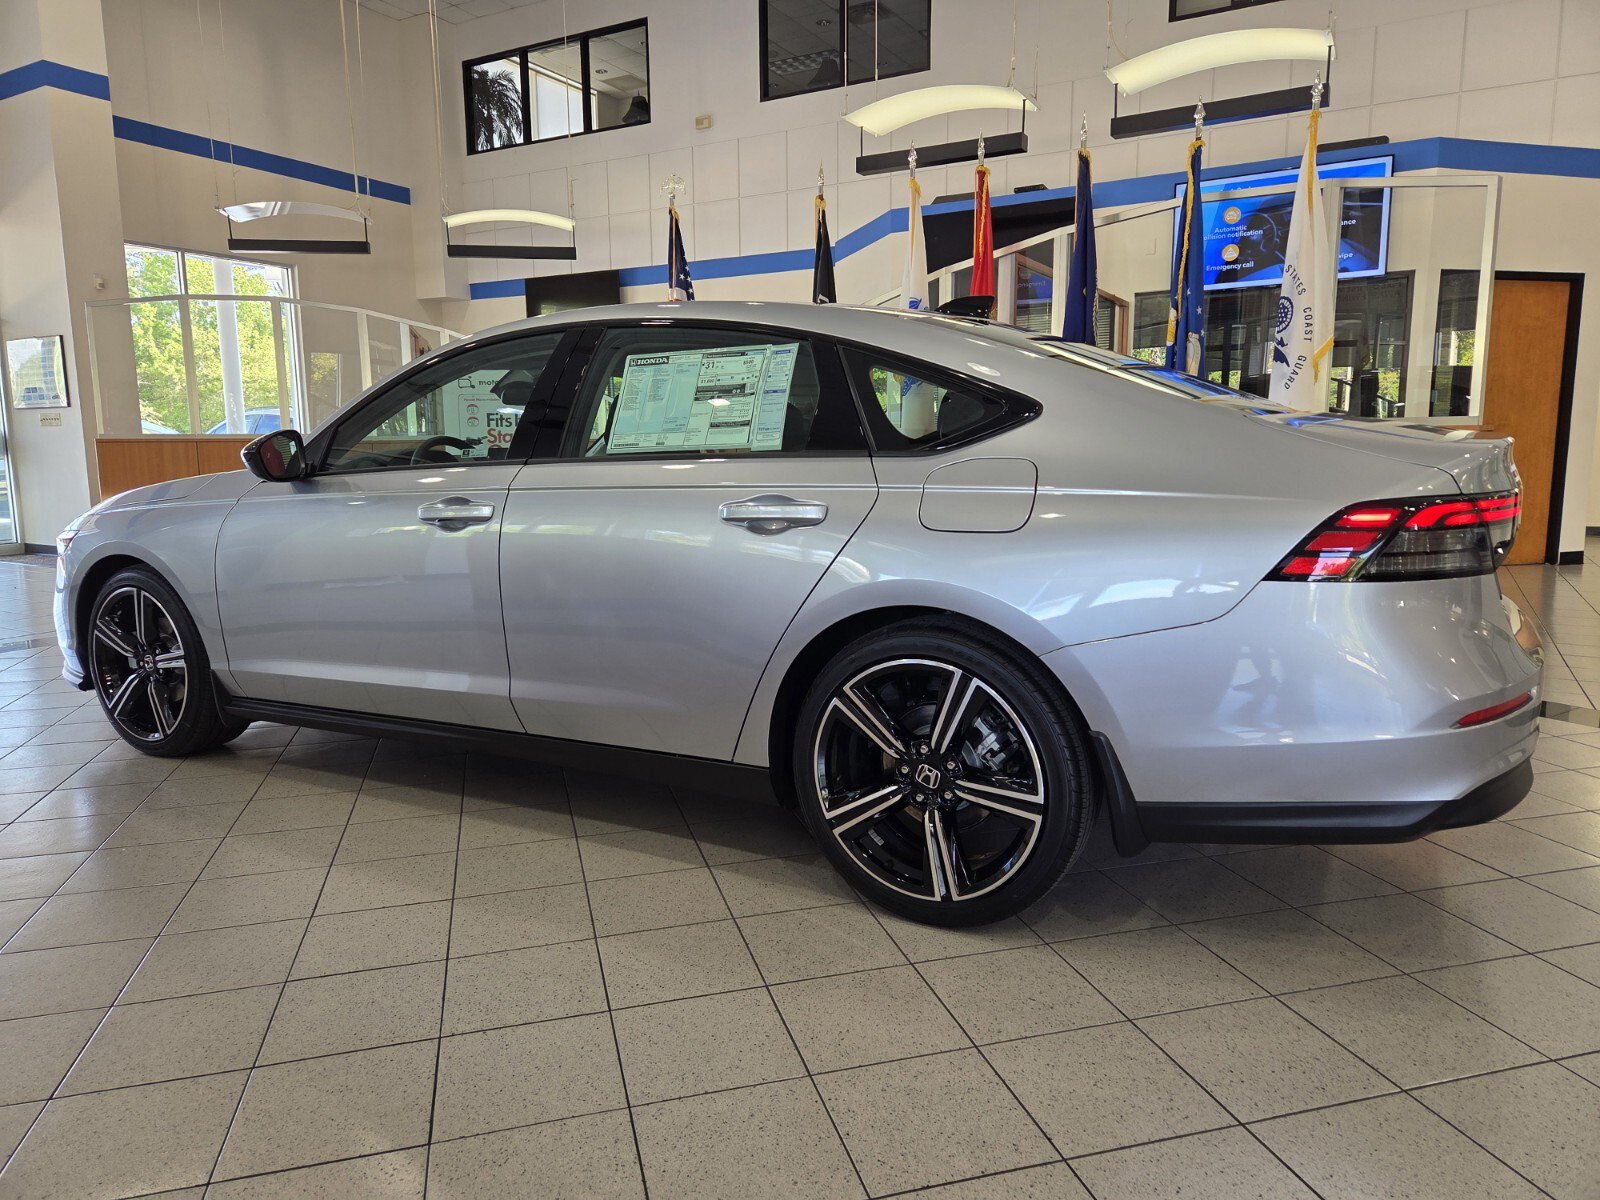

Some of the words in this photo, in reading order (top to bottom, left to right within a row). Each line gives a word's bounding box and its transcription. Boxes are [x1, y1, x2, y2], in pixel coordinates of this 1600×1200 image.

[1340, 218, 1356, 226] ance
[1203, 232, 1226, 240] ollision
[1227, 229, 1263, 238] notification
[1214, 225, 1247, 233] Automatic
[1206, 263, 1241, 271] Emergency
[1285, 264, 1306, 296] STATES
[1302, 306, 1313, 342] COAST
[637, 357, 669, 366] HONDA
[1284, 355, 1307, 390] GUARD
[486, 413, 512, 427] Fits
[487, 428, 512, 444] Sta
